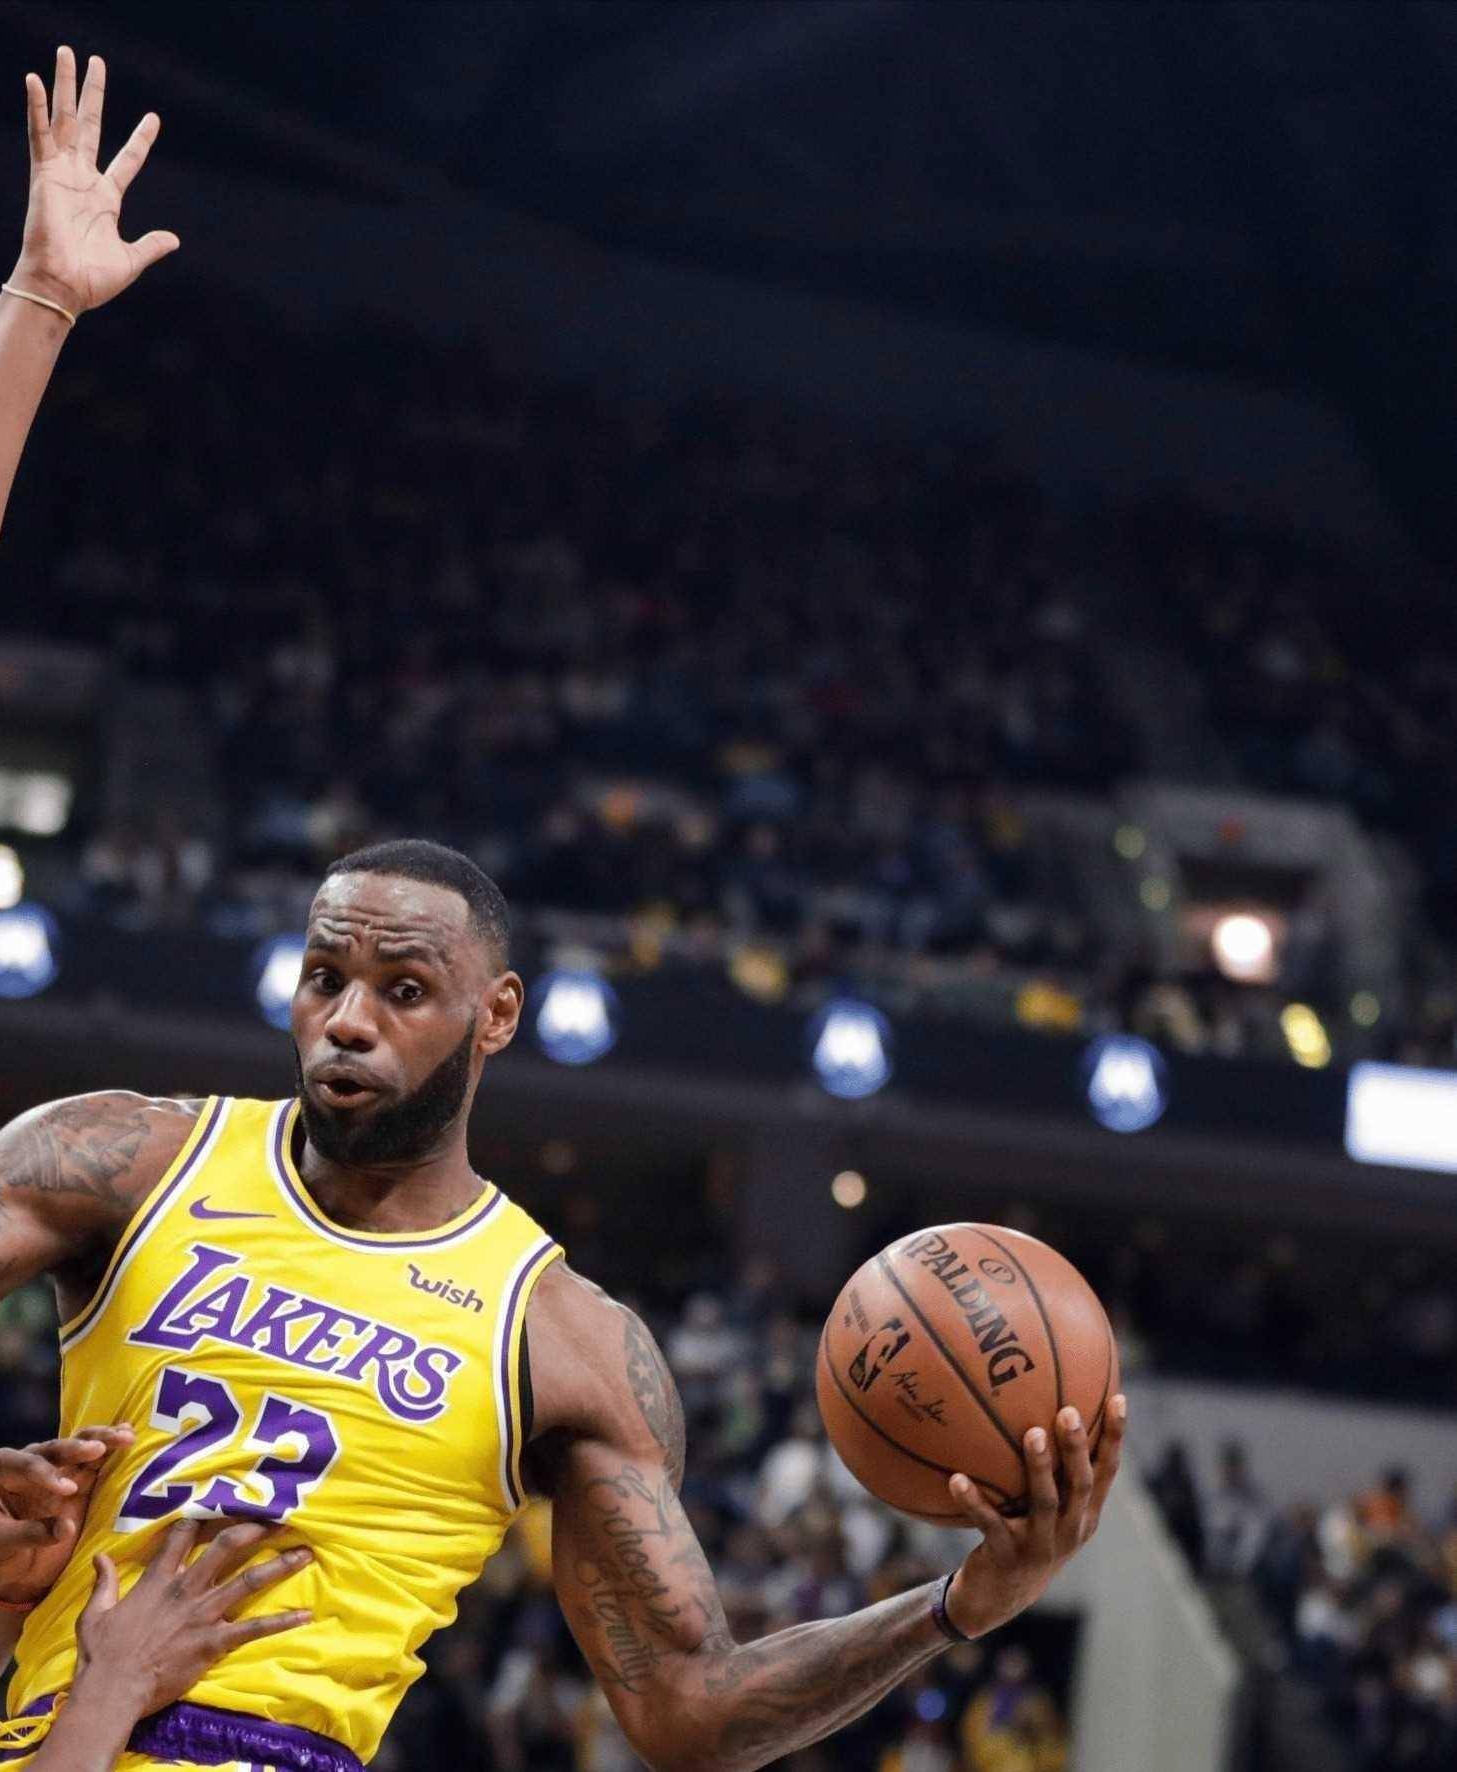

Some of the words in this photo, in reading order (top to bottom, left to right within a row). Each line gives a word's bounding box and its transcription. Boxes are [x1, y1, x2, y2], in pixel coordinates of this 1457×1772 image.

[127, 1243, 464, 1423] LAKERS
[406, 1262, 485, 1314] wish
[114, 1365, 340, 1534] 23
